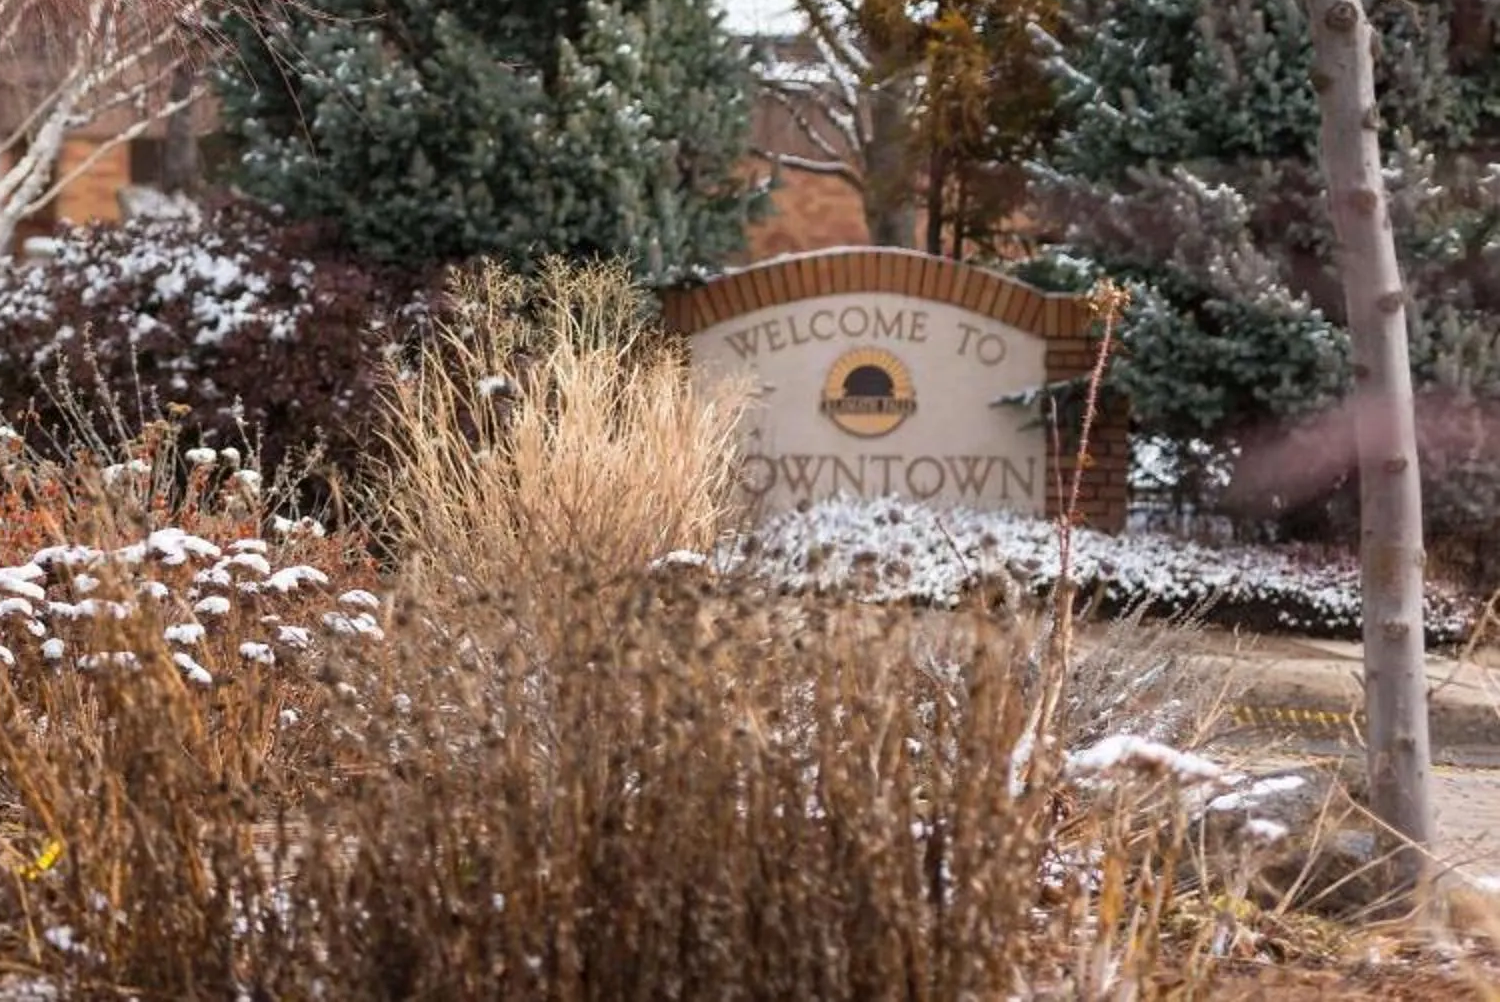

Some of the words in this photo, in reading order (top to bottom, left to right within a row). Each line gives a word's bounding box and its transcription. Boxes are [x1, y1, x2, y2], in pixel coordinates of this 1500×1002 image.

[724, 306, 929, 360] WELCOME
[957, 323, 1007, 367] TO
[734, 453, 1037, 499] OWNTOWN
